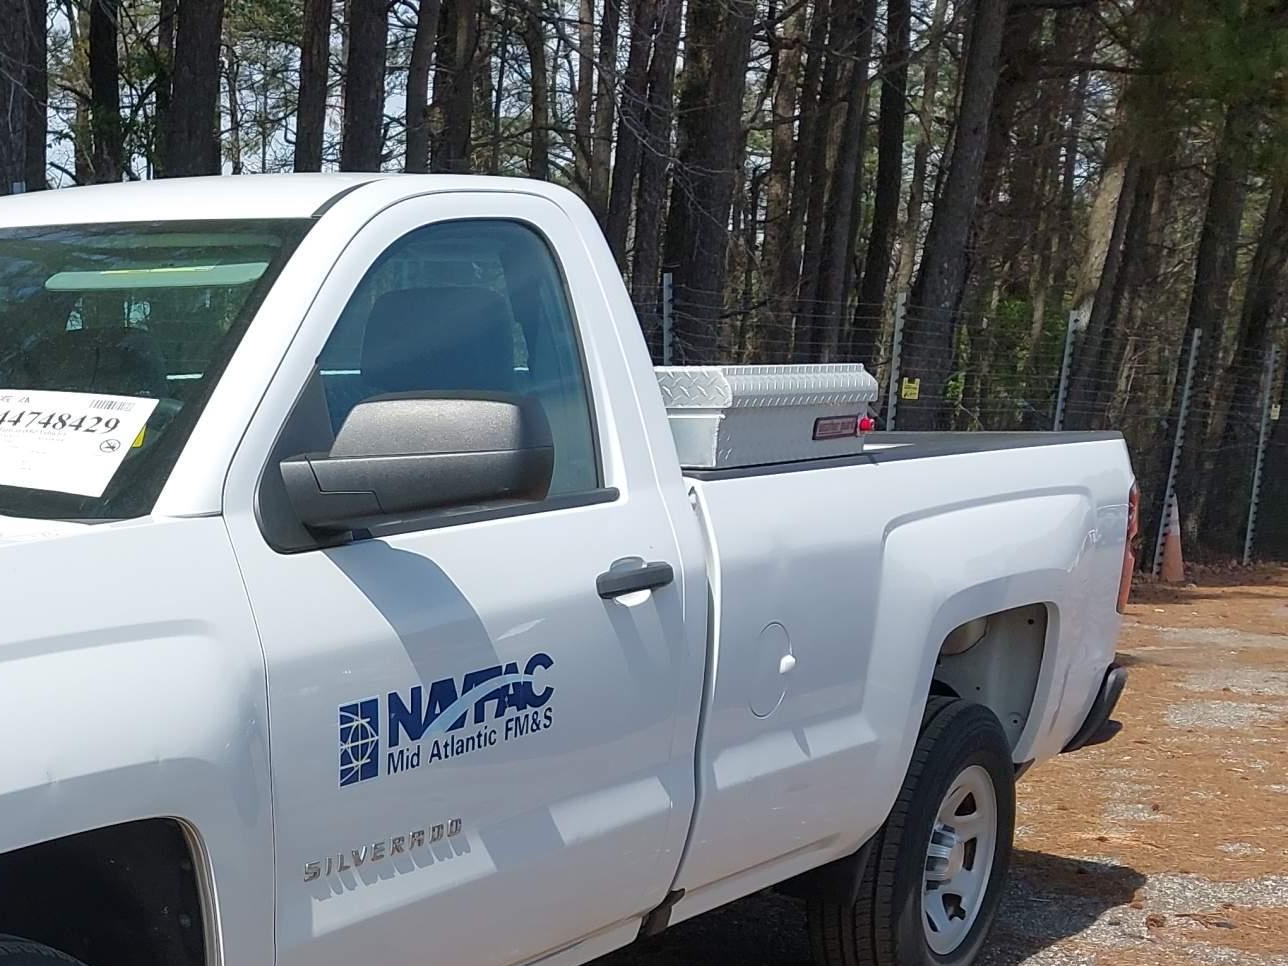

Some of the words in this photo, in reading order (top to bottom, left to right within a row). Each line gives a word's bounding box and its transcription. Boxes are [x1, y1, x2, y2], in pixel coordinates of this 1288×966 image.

[387, 745, 420, 775] Mid
[428, 725, 497, 763] Atlantic
[504, 707, 553, 741] FM&S
[304, 818, 462, 882] SILVERADO
